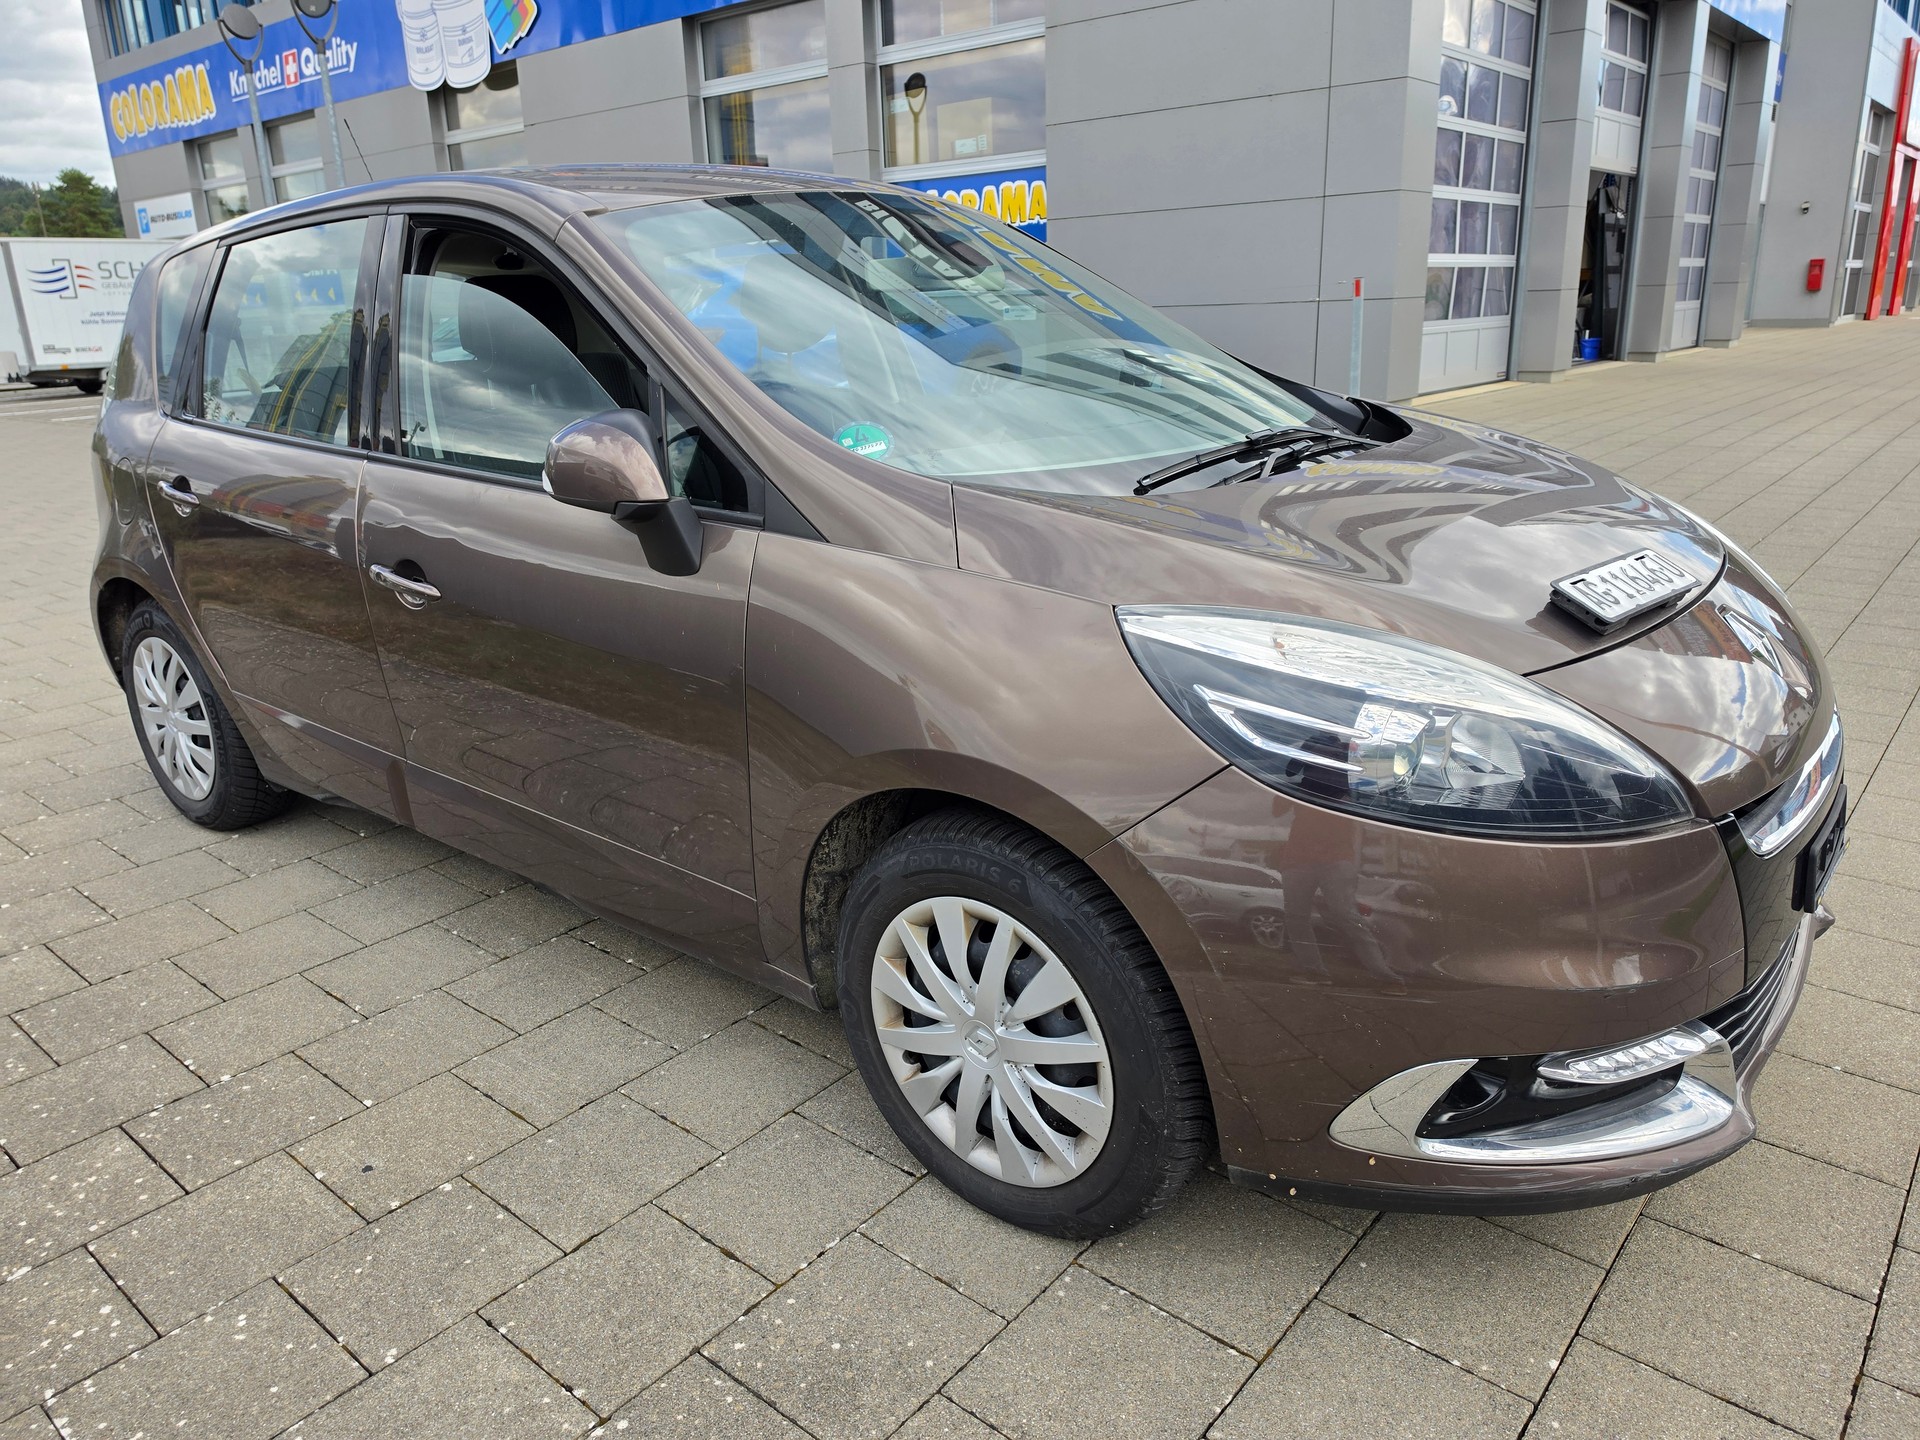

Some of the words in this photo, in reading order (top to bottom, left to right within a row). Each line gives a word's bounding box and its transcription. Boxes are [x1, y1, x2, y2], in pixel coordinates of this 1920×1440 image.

[229, 54, 281, 97] Knchel
[110, 63, 217, 143] COLORAMA
[909, 854, 1001, 882] POLARIS
[1008, 878, 1022, 893] 6
